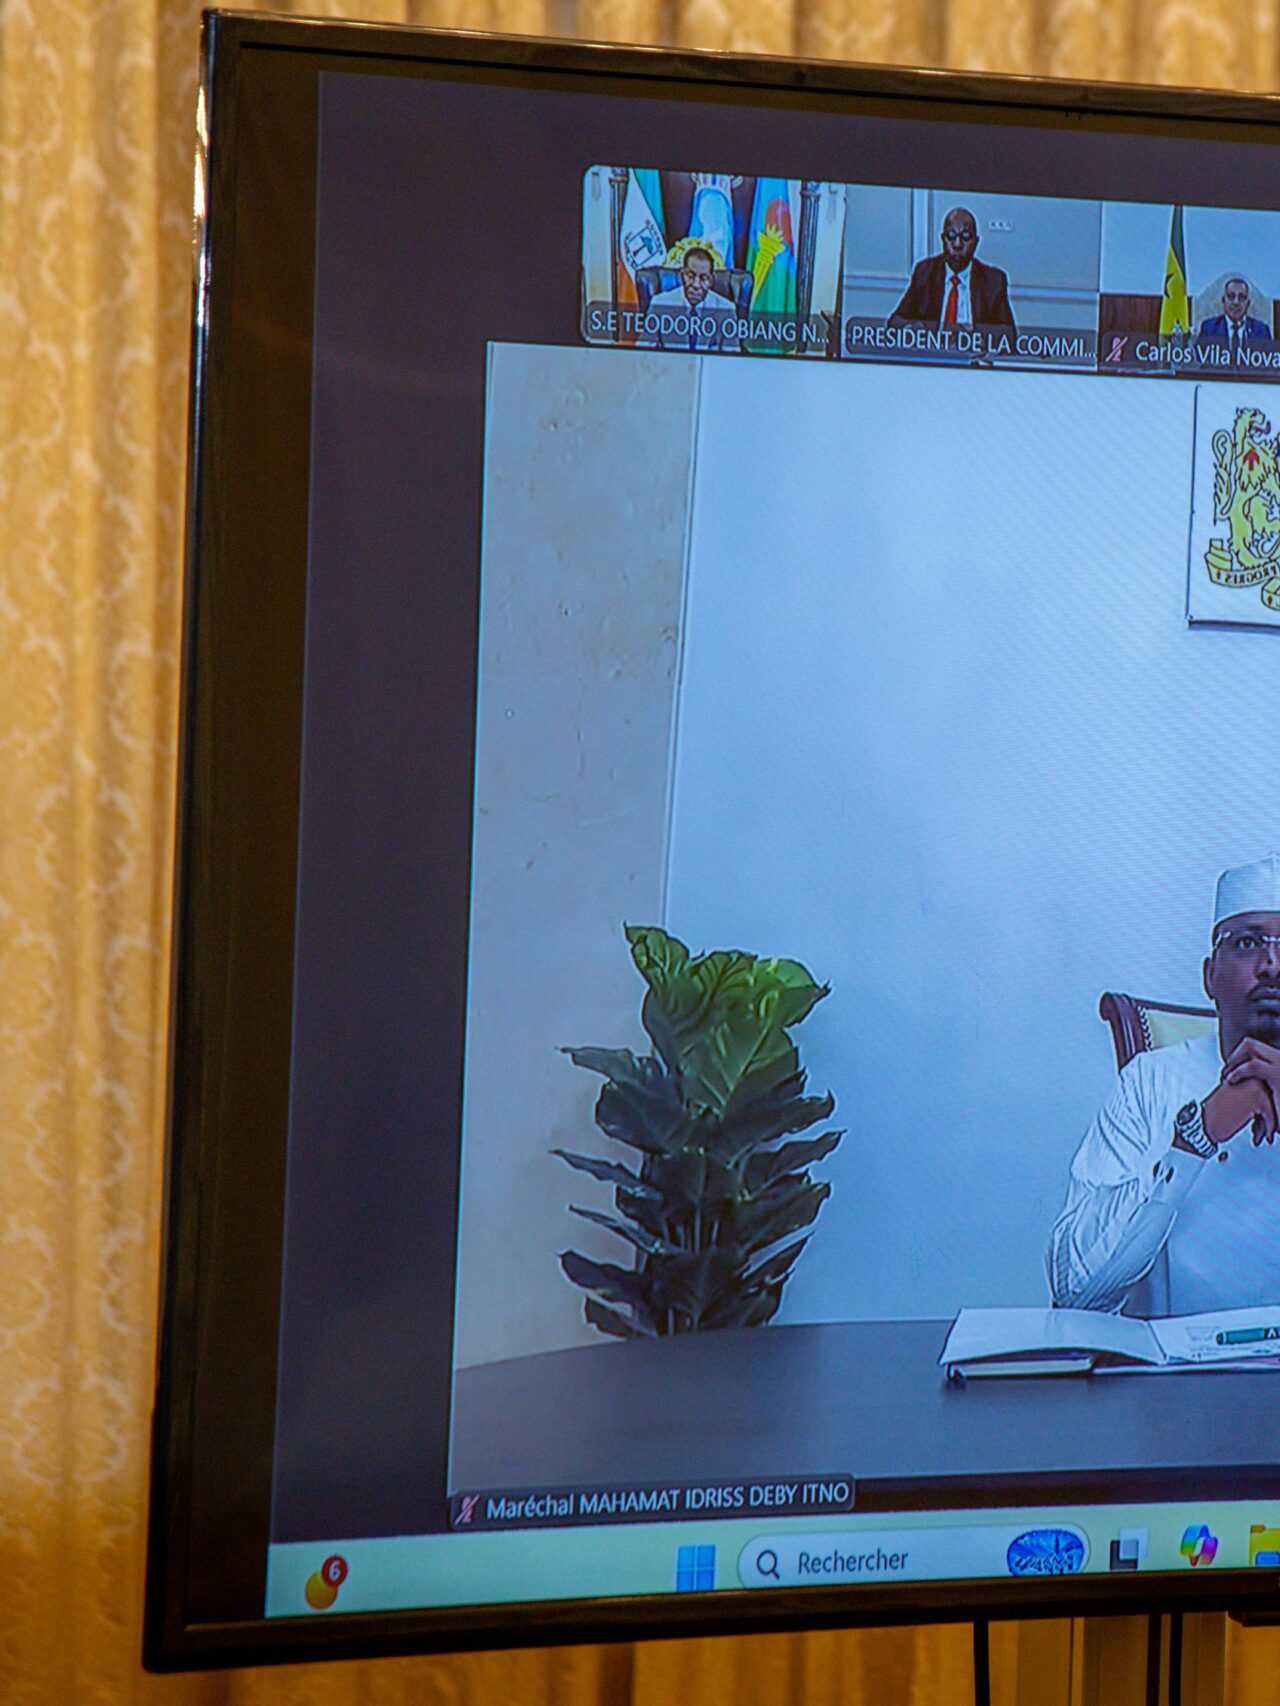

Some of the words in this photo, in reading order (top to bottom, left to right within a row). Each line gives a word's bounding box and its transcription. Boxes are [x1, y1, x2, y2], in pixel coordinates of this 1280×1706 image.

[591, 310, 617, 331] S.E
[623, 312, 716, 337] TEODORO
[721, 318, 796, 341] OBIANG
[851, 326, 952, 350] PRESIDENT
[958, 332, 981, 352] DE
[987, 333, 1011, 354] LA
[1135, 341, 1192, 363] Carlos
[1196, 344, 1230, 365] Vila
[486, 1493, 574, 1519] Maréchal
[579, 1488, 680, 1515] MAHAMAT
[685, 1486, 744, 1510] IDRISS
[750, 1484, 798, 1507] DEBY
[802, 1482, 849, 1504] ITNO
[329, 1560, 341, 1581] 6
[798, 1547, 908, 1574] Rechercher
